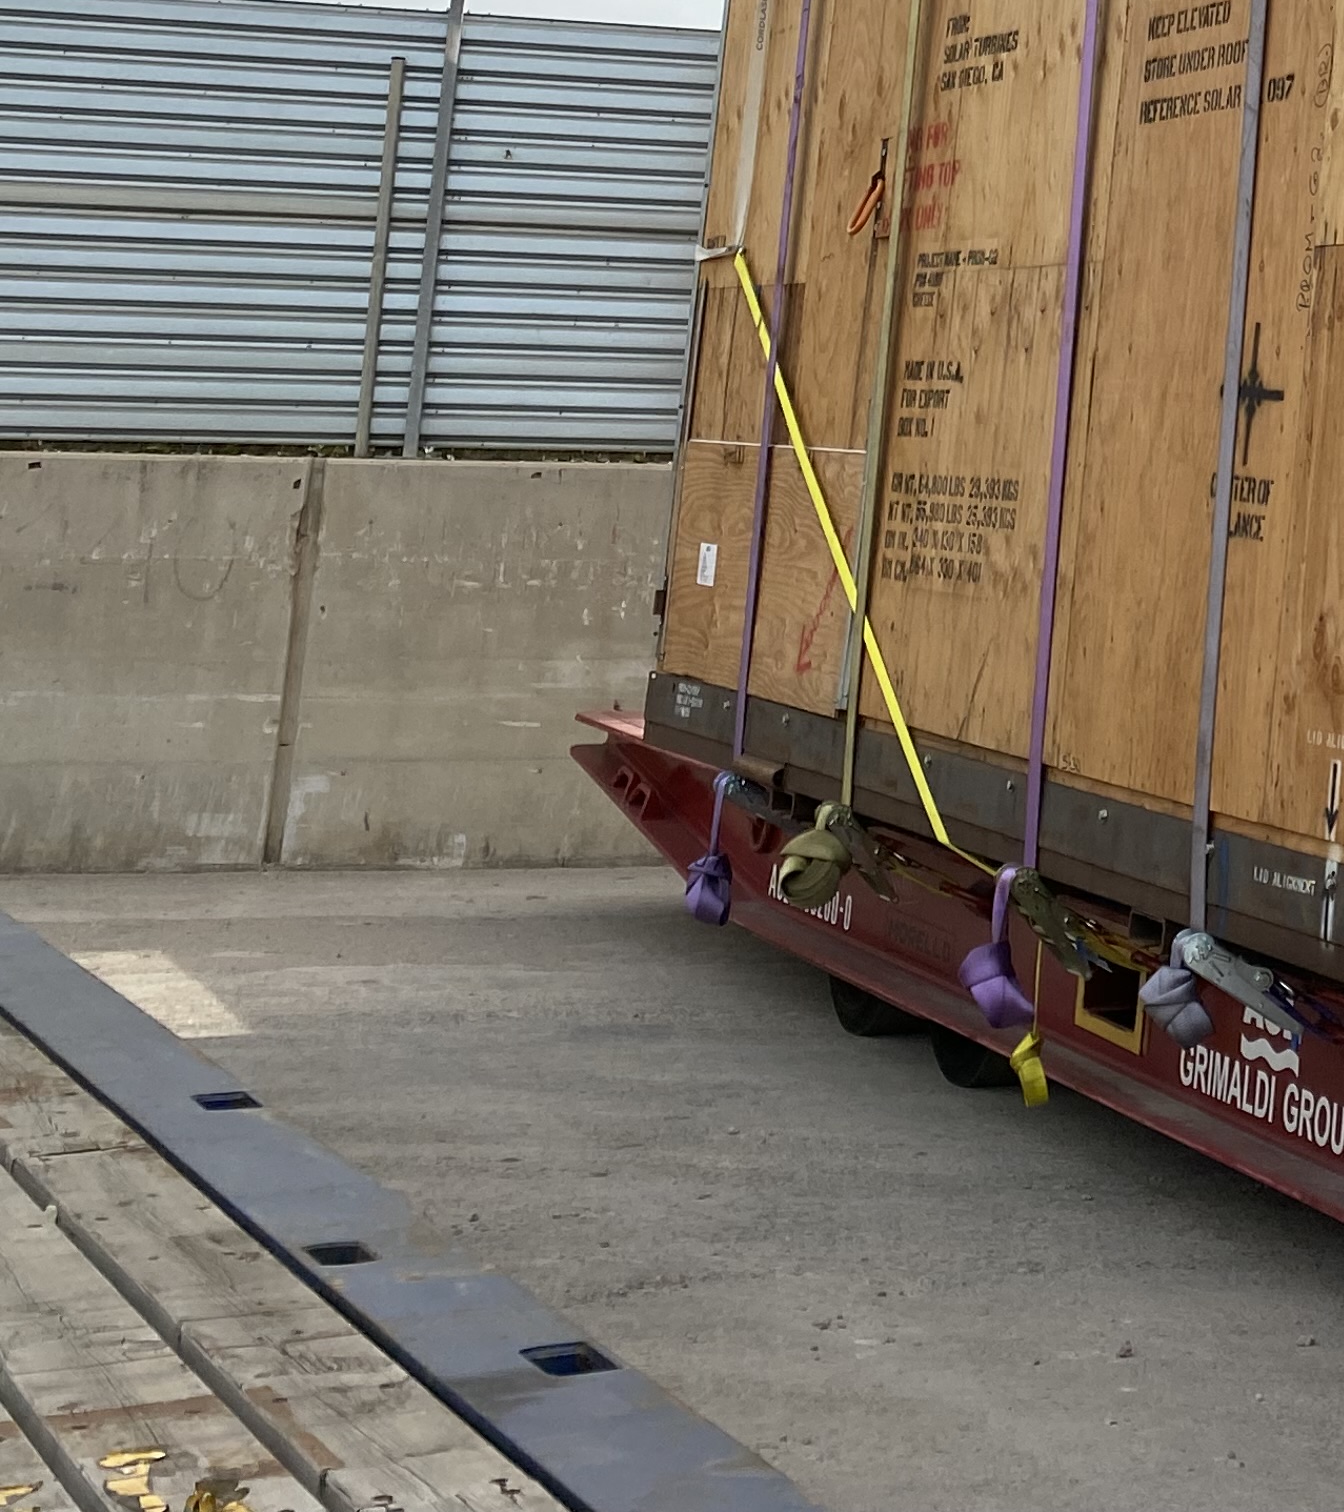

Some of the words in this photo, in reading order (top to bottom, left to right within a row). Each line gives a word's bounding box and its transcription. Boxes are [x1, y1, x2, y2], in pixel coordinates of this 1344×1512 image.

[1148, 13, 1175, 42] KEEP
[1176, 0, 1231, 34] ELEVATED
[974, 29, 1019, 57] TURBINES
[1144, 53, 1177, 83] STORE
[1178, 45, 1216, 74] UNDER
[940, 70, 957, 92] SAN
[1139, 91, 1201, 125] REFERENCE
[1203, 84, 1242, 113] SOLAR
[901, 388, 917, 408] FOR
[918, 389, 951, 409] EXPORT
[897, 416, 914, 437] BOX
[1307, 729, 1323, 746] LID
[1253, 866, 1269, 884] LID
[1179, 1044, 1277, 1123] GRIMALDI
